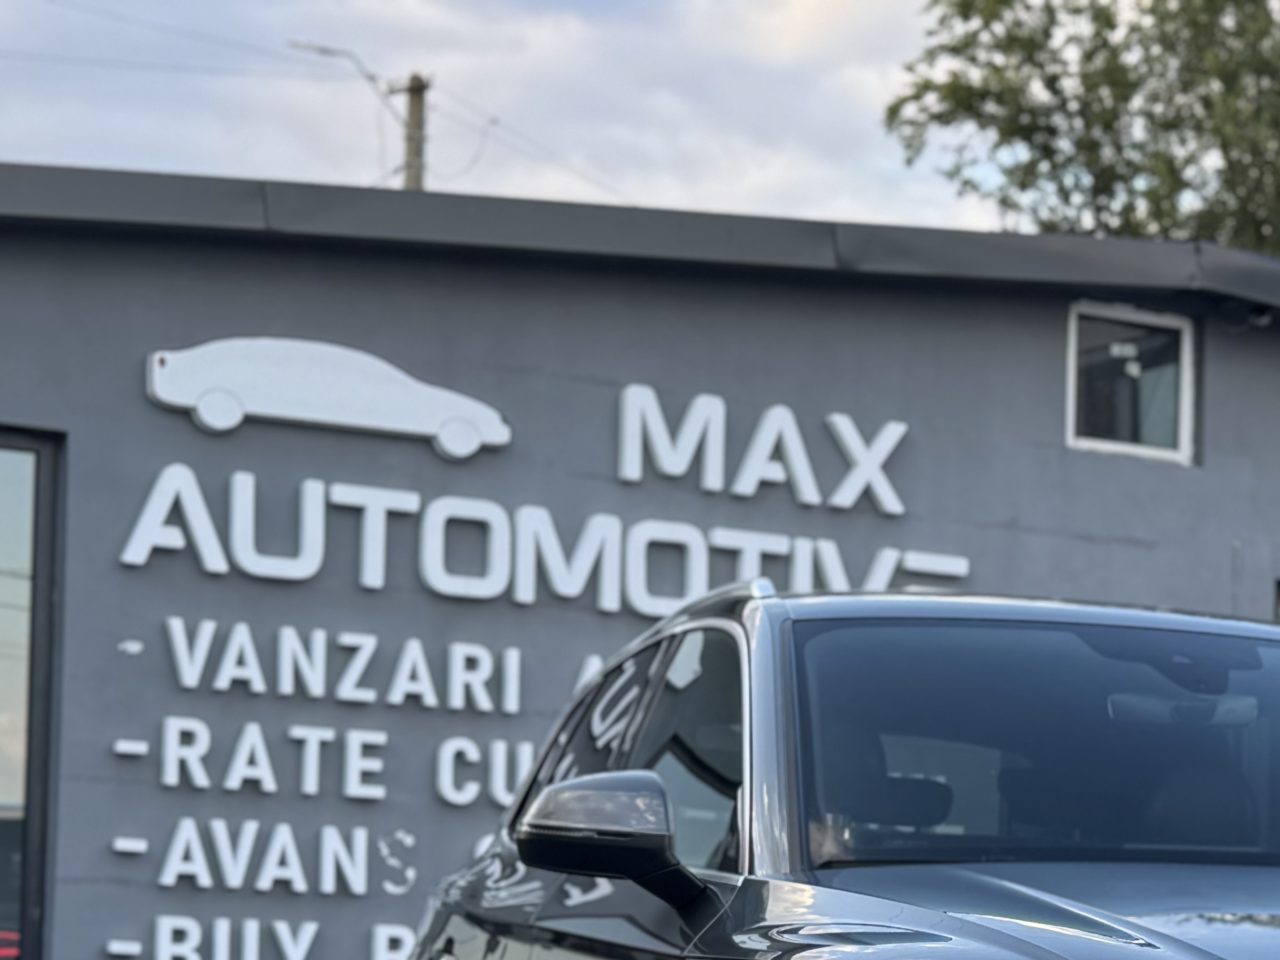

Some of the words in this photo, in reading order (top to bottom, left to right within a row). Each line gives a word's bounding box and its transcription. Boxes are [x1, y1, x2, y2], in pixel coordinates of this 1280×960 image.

[617, 382, 909, 516] MAX
[119, 462, 970, 618] AUTOMOTIV
[165, 615, 522, 715] VANZARI
